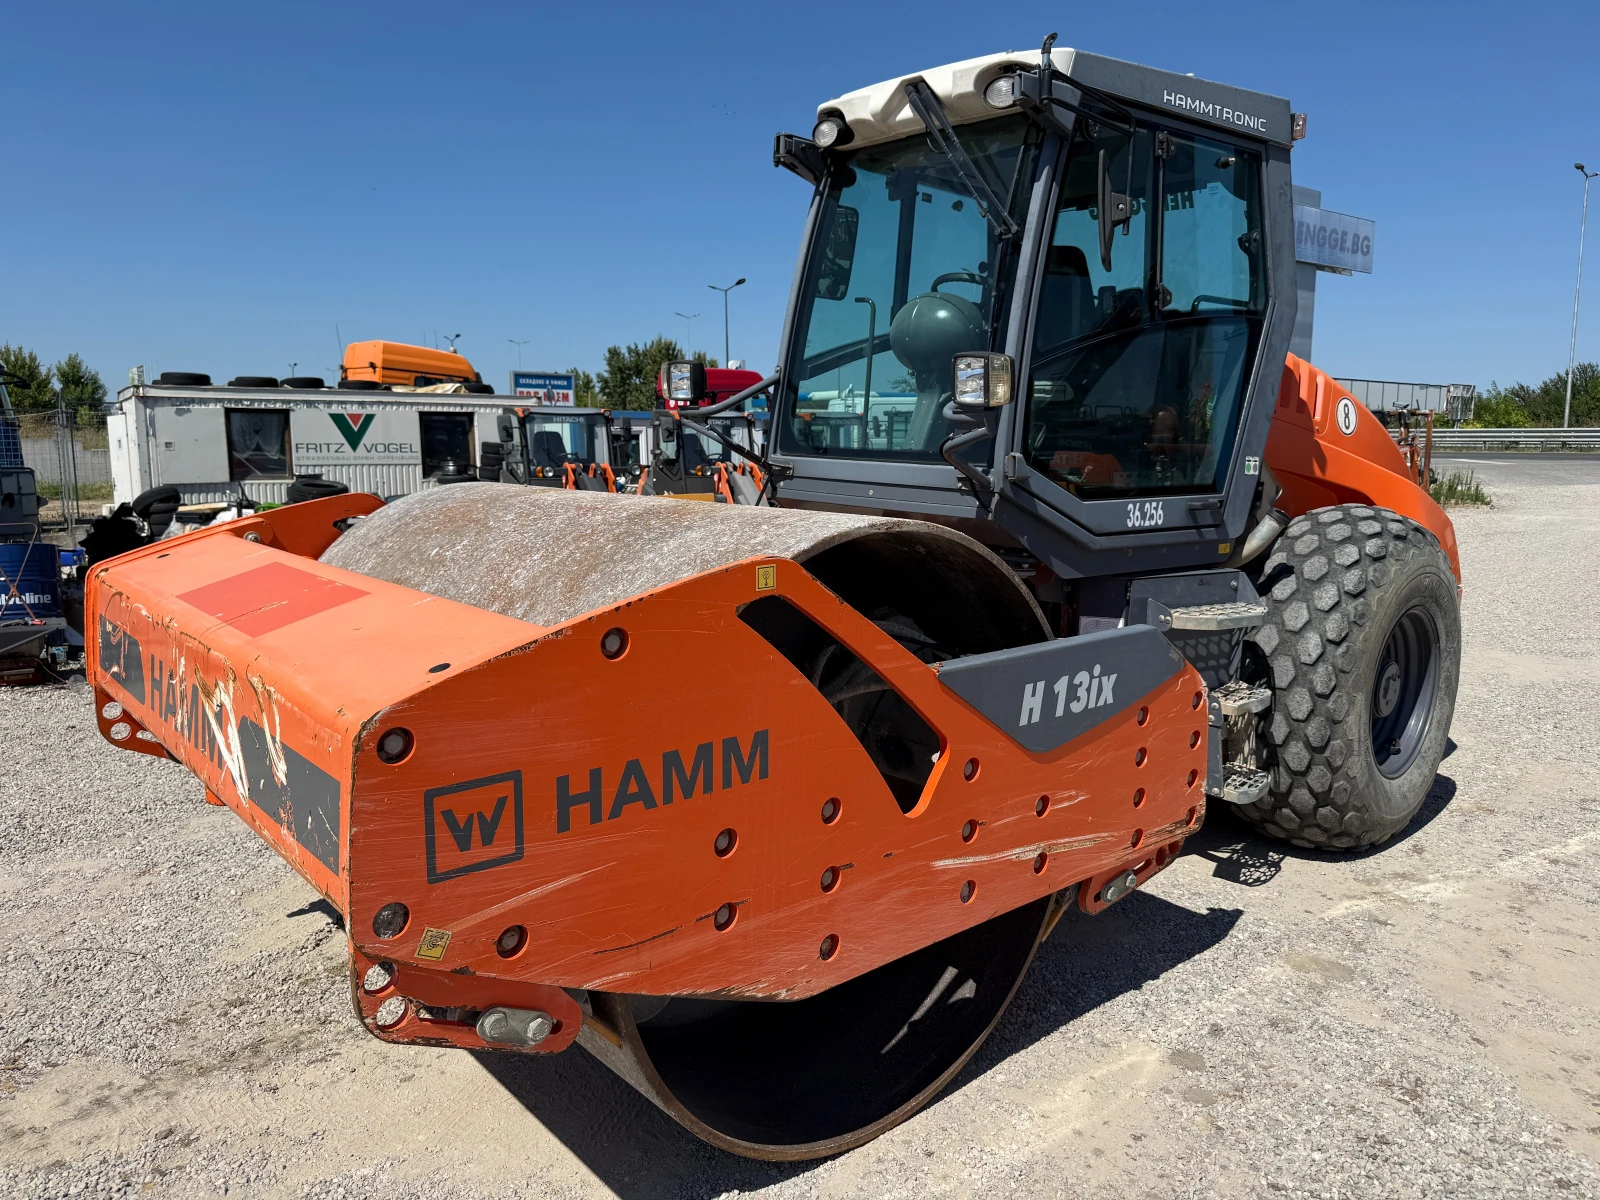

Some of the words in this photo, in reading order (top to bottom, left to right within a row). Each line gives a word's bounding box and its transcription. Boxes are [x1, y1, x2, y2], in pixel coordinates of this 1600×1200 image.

[1163, 89, 1268, 133] HAMMTRONIC
[1294, 220, 1371, 257] ENGGE.BG
[1343, 402, 1351, 430] 8
[295, 442, 346, 454] FRITZ
[362, 442, 419, 454] VOGEL
[1126, 501, 1164, 528] 36.256
[1018, 680, 1046, 727] H
[1053, 663, 1118, 718] 13ix
[556, 728, 769, 834] HAMM
